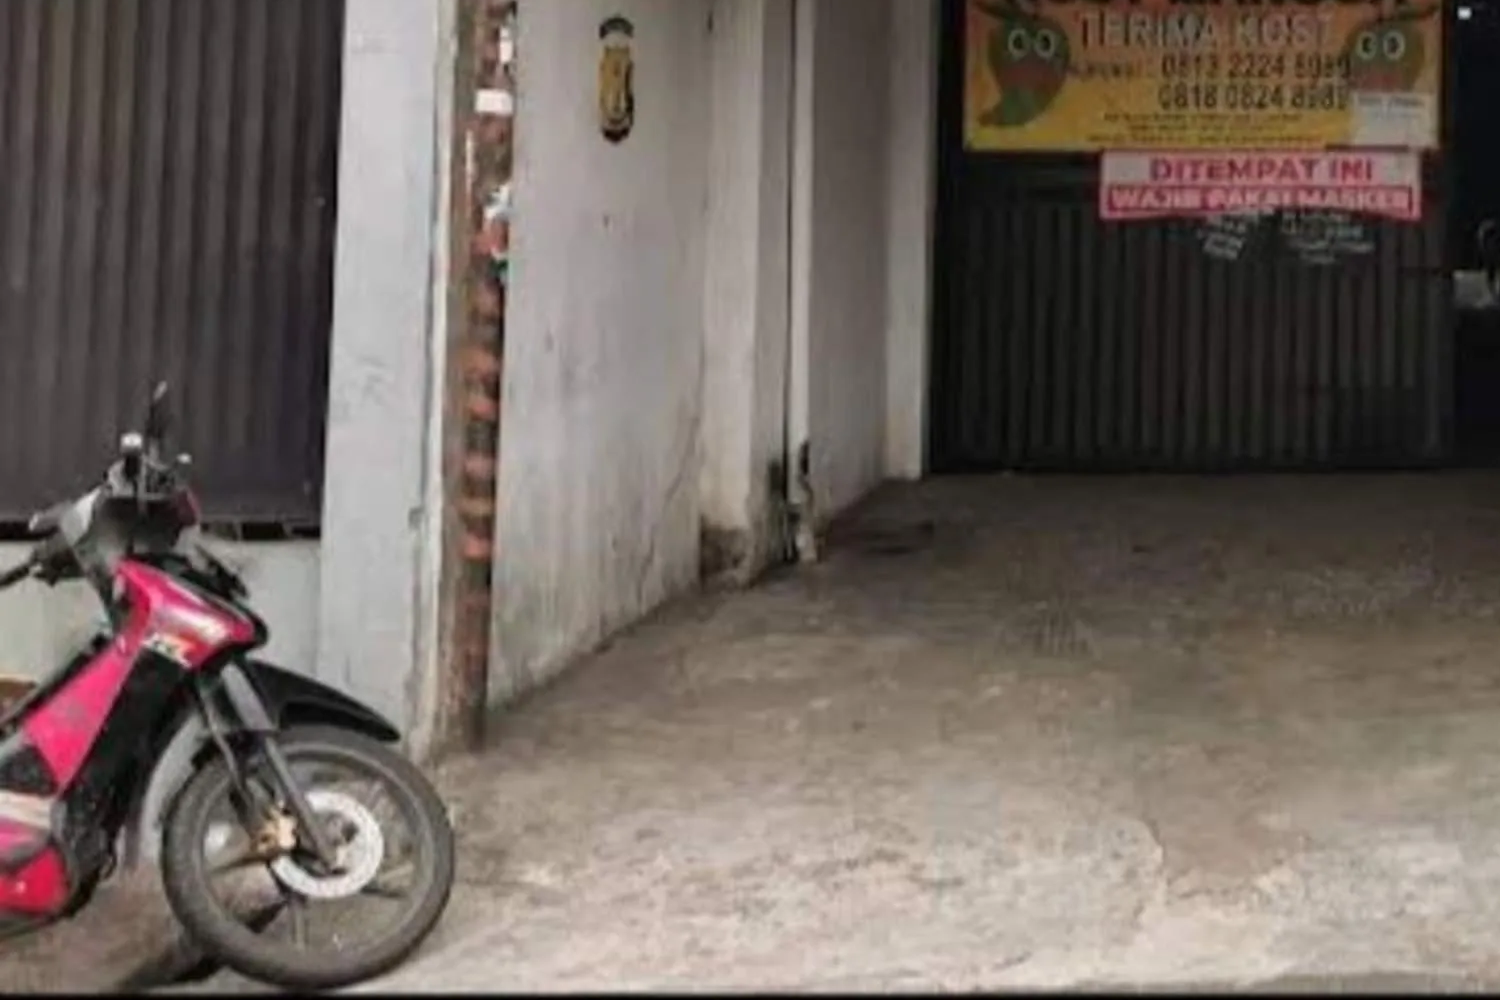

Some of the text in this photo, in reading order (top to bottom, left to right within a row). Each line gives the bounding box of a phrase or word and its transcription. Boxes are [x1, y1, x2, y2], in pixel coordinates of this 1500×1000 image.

[1081, 12, 1334, 49] TERIMA KOST
[1152, 157, 1372, 181] DITEMPAT INI
